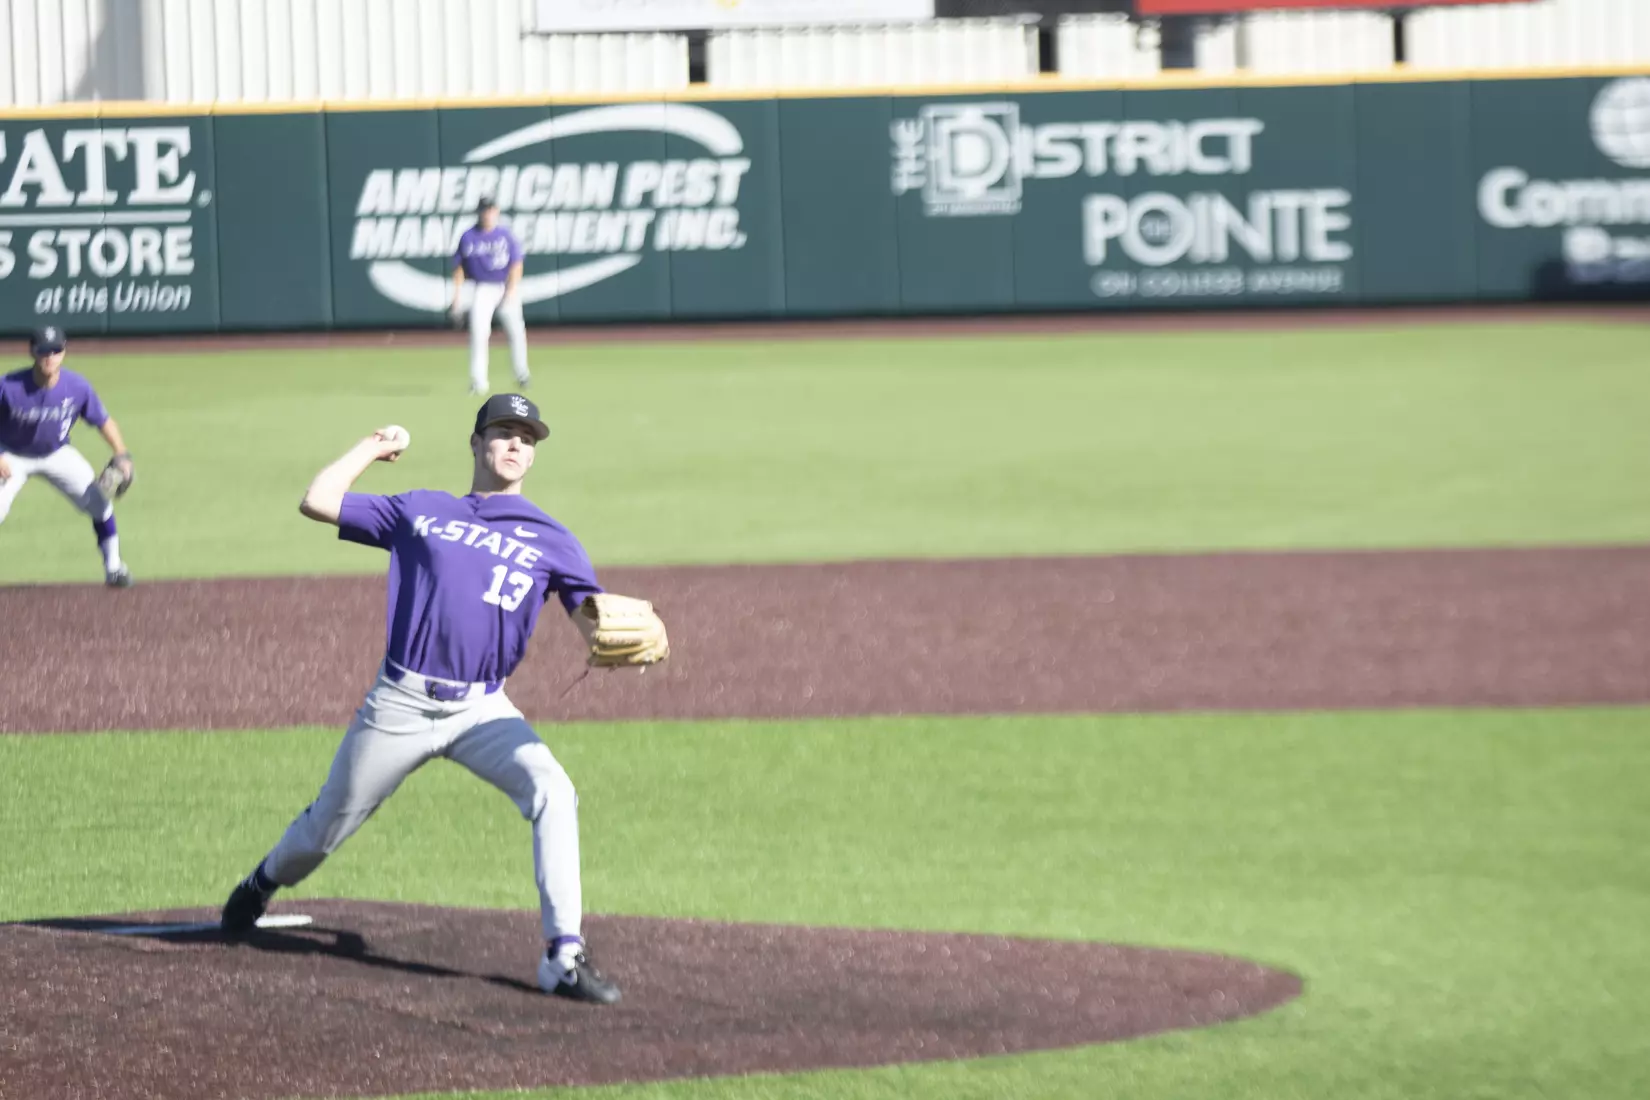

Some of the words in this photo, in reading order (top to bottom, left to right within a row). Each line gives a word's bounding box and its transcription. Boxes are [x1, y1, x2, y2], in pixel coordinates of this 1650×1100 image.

[0, 126, 195, 207] ATE
[936, 117, 1264, 193] DISTRICT
[356, 162, 618, 216] AMERICAN
[621, 156, 750, 206] PEST
[28, 225, 195, 279] STORE
[654, 206, 747, 249] INC.
[1083, 190, 1352, 265] POINTE
[34, 285, 64, 314] at
[67, 281, 108, 314] the
[113, 281, 191, 312] Union
[413, 515, 543, 570] K-STATE
[482, 565, 534, 612] 13
